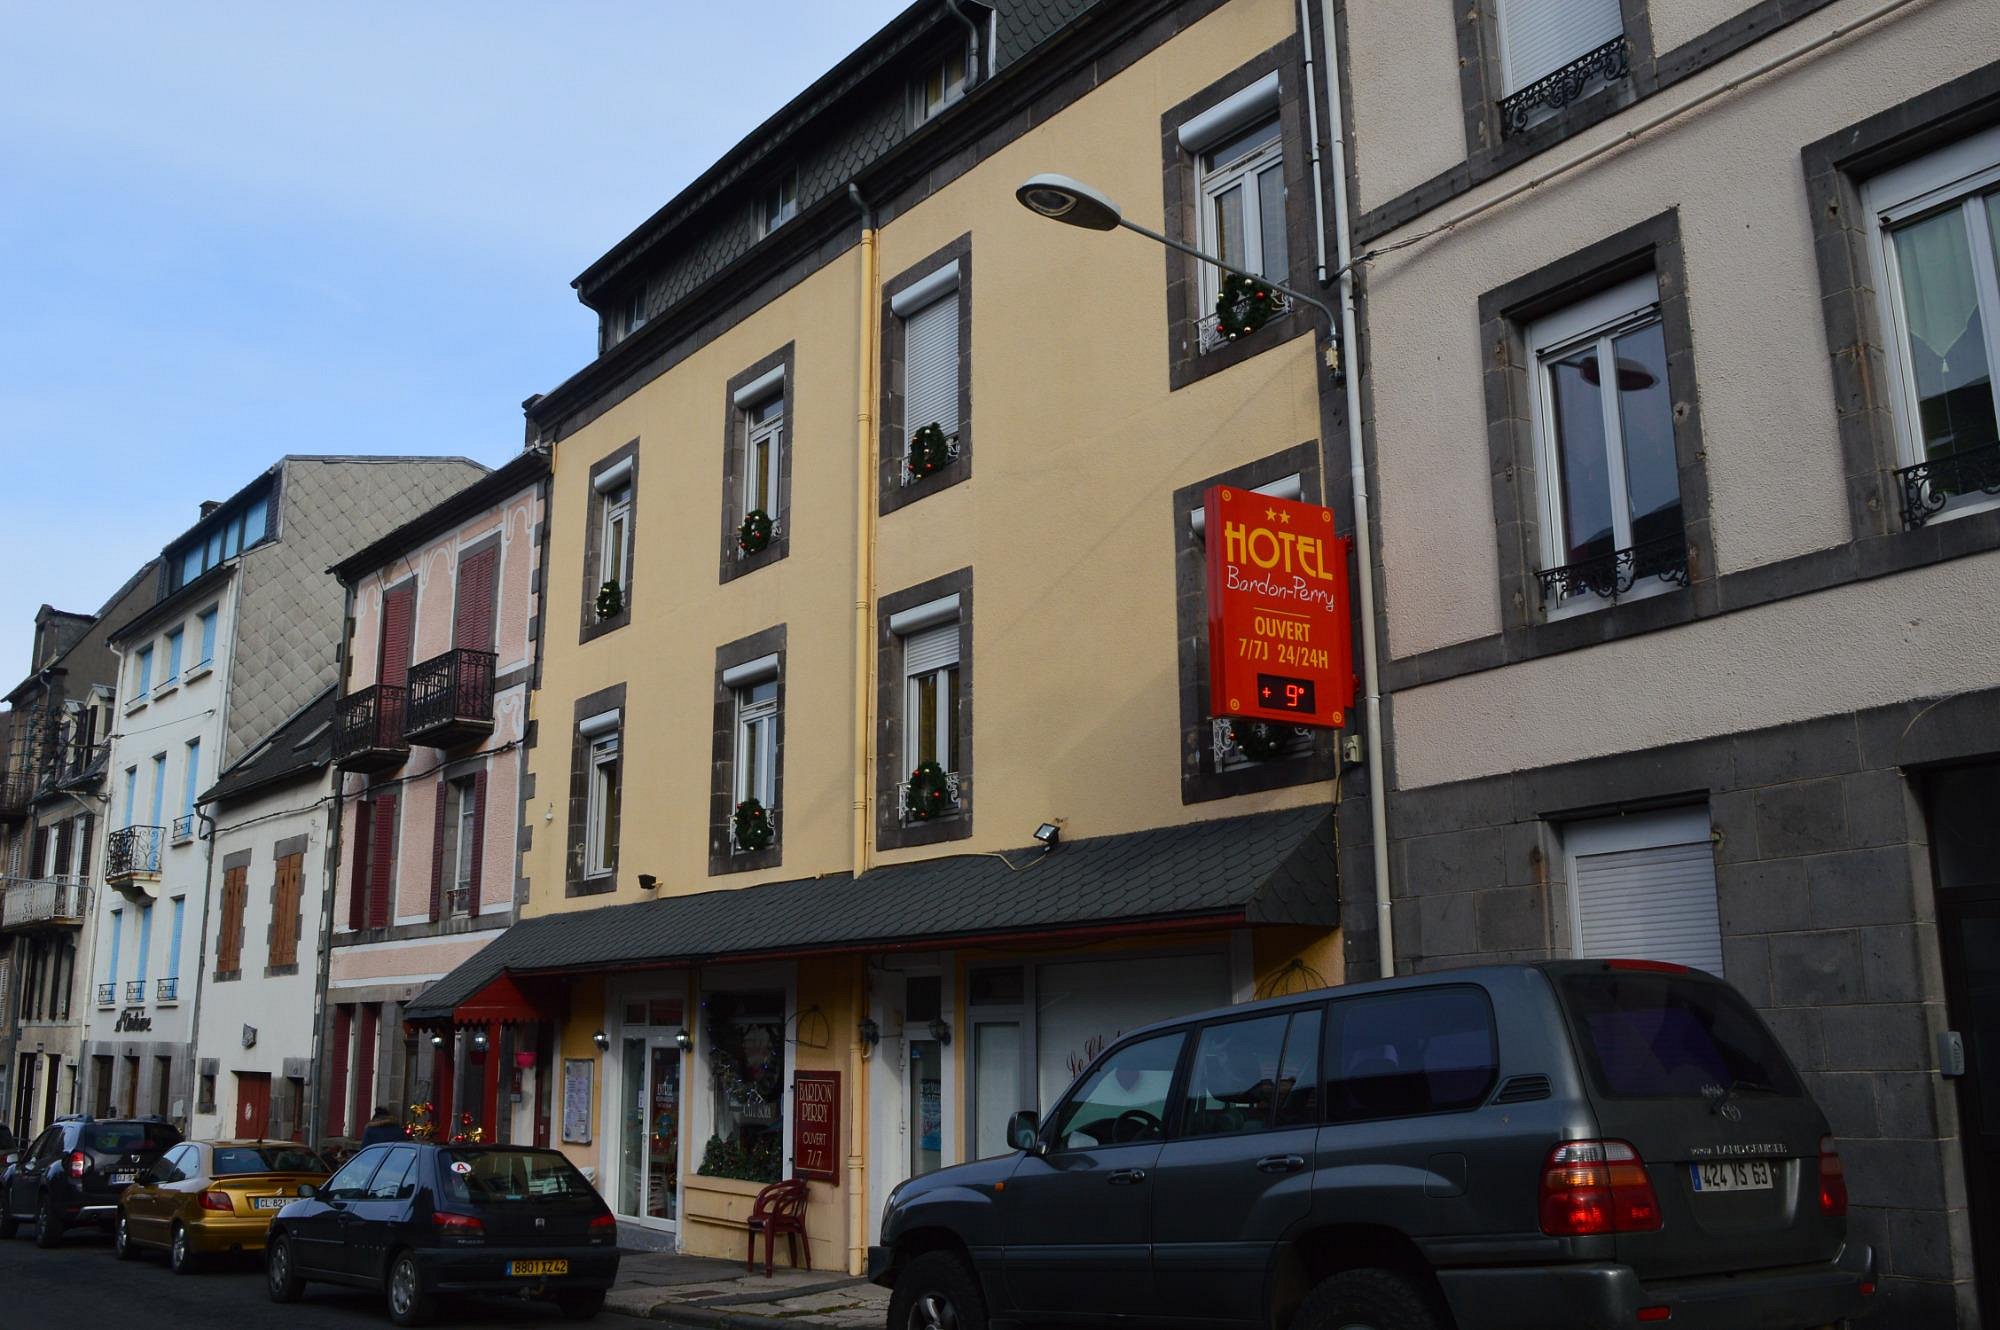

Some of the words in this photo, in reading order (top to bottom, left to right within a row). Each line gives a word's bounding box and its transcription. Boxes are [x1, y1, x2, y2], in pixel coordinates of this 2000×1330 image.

[1225, 521, 1333, 580] HOTEL
[1227, 565, 1334, 612] Bardon-Perry
[1255, 616, 1310, 642] OUVERT
[1239, 638, 1268, 660] 7/7J
[1278, 644, 1328, 669] 24/24H
[800, 1082, 832, 1102] BARDON
[802, 1103, 828, 1123] PERRY
[803, 1131, 827, 1146] OUVERT
[457, 1163, 468, 1171] A
[1704, 1161, 1727, 1187] 424
[1729, 1160, 1748, 1186] YS
[1752, 1161, 1768, 1185] 63
